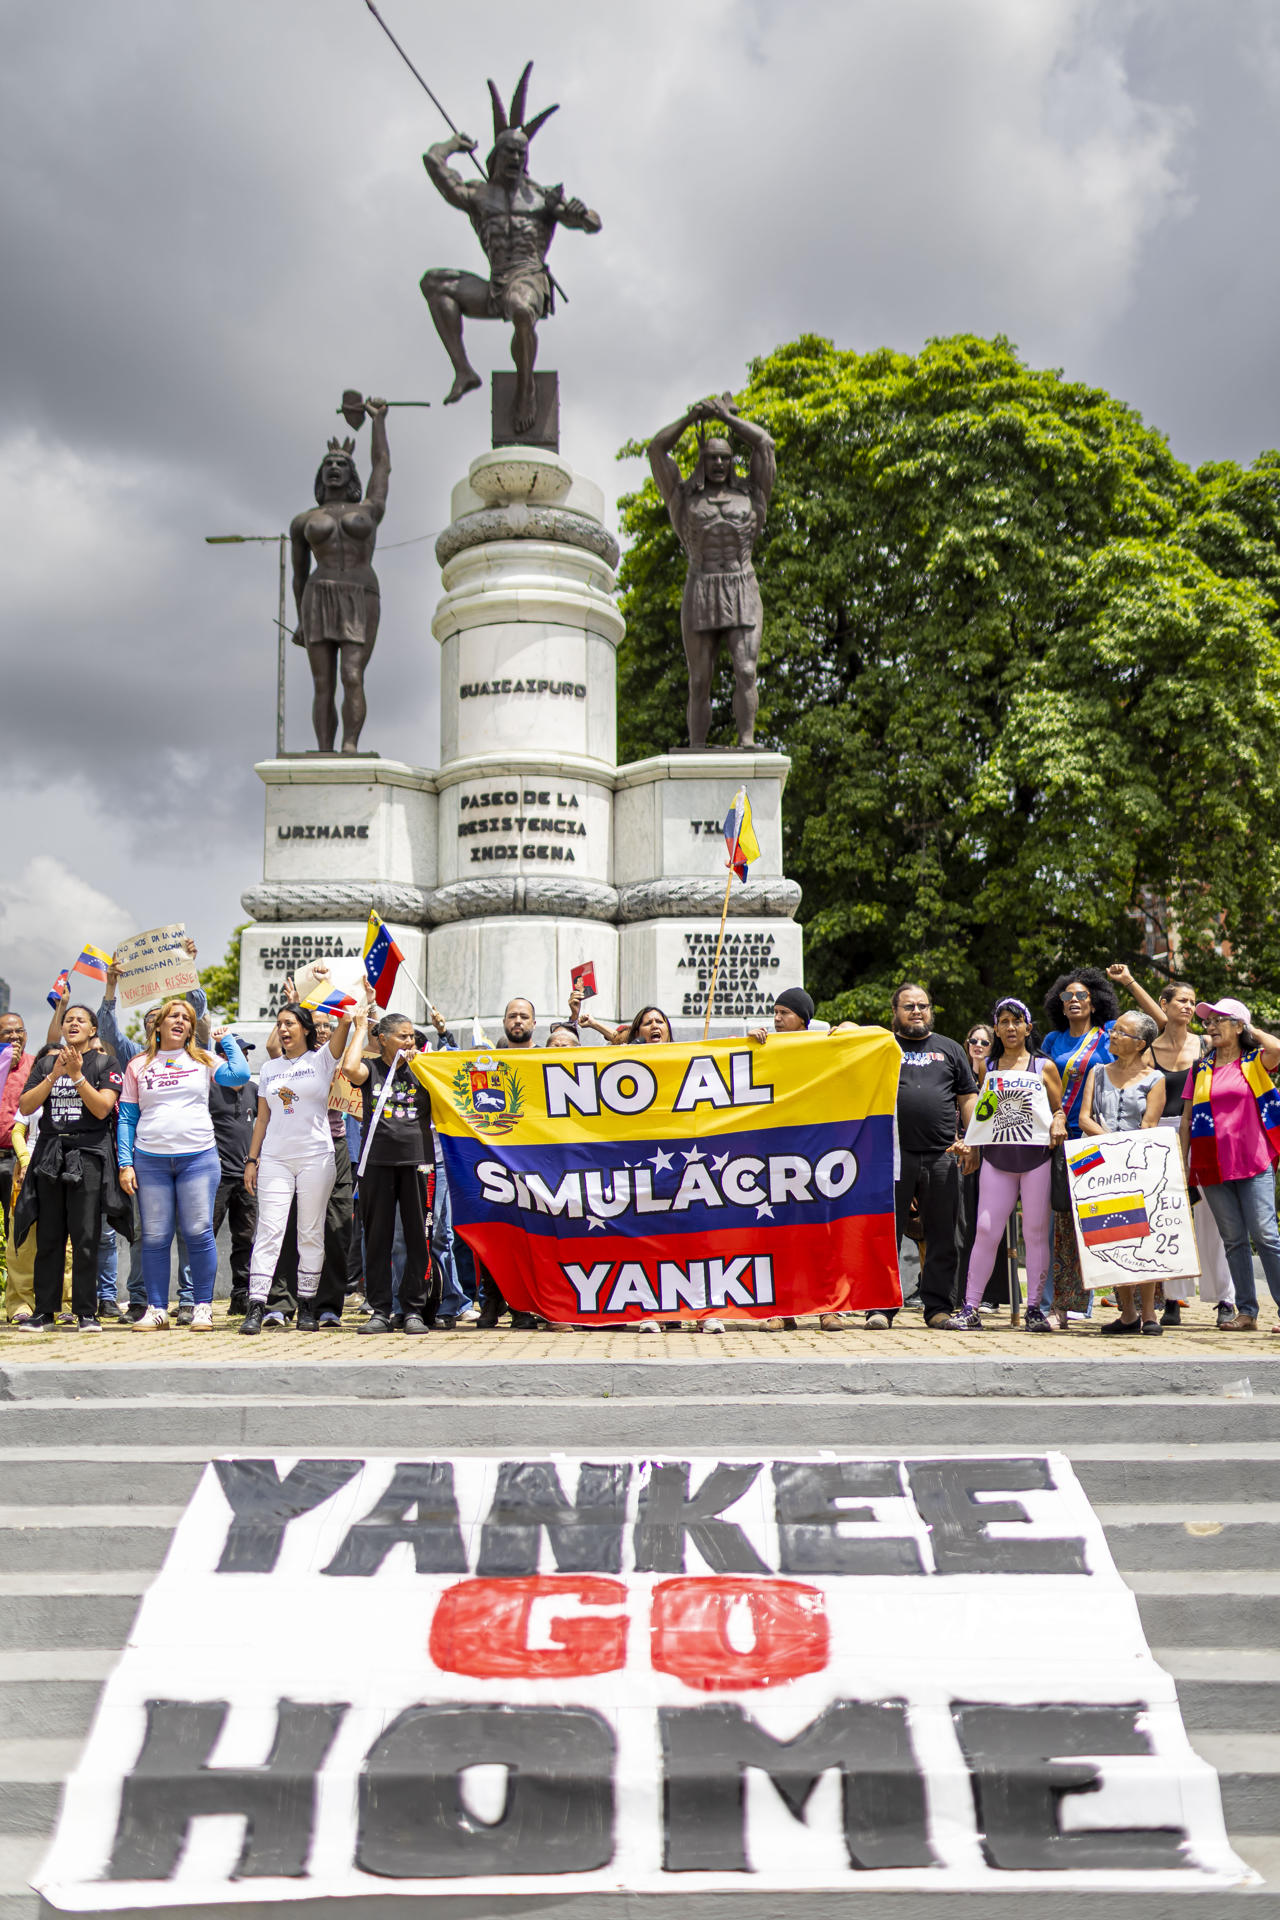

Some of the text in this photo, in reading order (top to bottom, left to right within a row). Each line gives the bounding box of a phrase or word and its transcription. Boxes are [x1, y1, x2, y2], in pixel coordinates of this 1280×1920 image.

[460, 679, 586, 699] GUAICAIPURO
[461, 790, 579, 810] PASEO DE LA
[278, 825, 369, 839] URIMARE
[458, 817, 586, 837] RESISTENCIA
[282, 936, 343, 946] URQUIA
[689, 945, 771, 956] TAMANACO
[698, 969, 759, 980] CHACAO
[699, 981, 757, 992] BARUTA
[543, 1050, 774, 1118] NO AL
[474, 1147, 858, 1220] SIMULACRO
[1087, 1172, 1137, 1190] CANADA
[1155, 1233, 1180, 1256] 25
[561, 1254, 775, 1314] YANKI
[212, 1457, 1094, 1577] YANKEE
[428, 1575, 832, 1692] GO
[106, 1697, 1200, 1881] HOME
